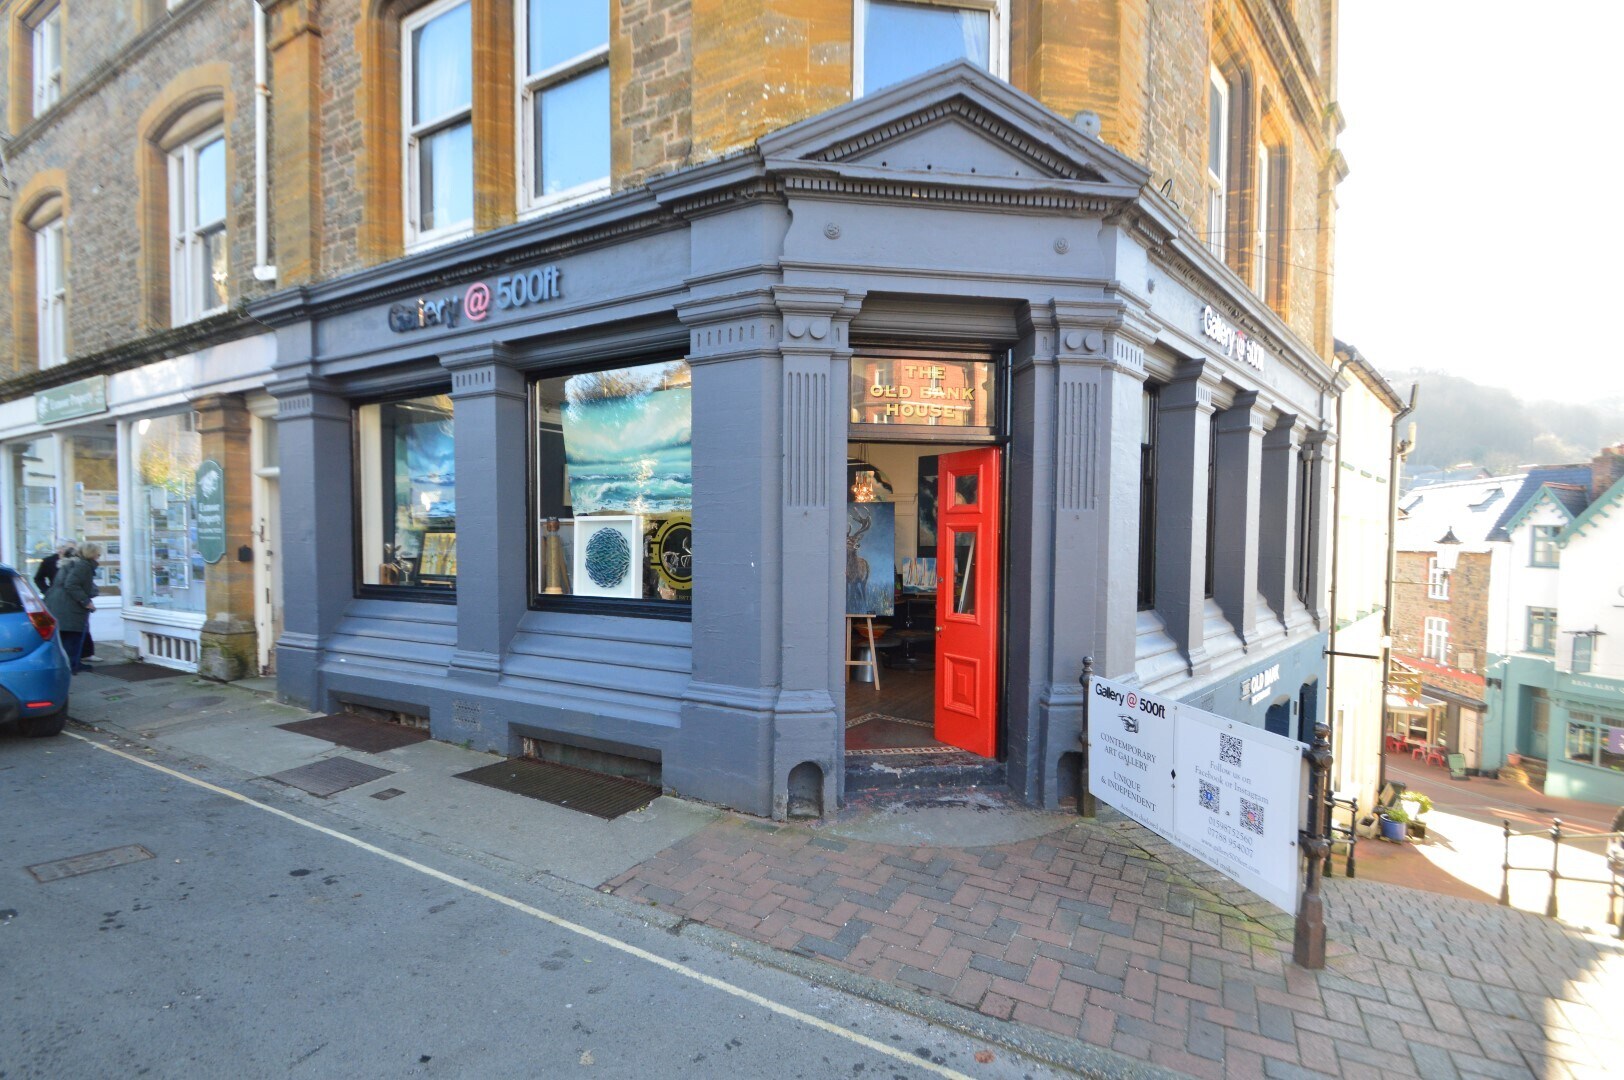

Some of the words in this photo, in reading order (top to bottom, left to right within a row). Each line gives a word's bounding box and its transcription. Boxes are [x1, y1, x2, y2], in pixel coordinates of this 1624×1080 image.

[463, 281, 491, 322] @
[496, 265, 561, 311] 500ft
[1204, 304, 1237, 357] Gallery
[905, 365, 947, 381] THE
[870, 384, 913, 400] OLD
[919, 386, 976, 401] BANK
[886, 402, 956, 419] HOUSE
[1095, 682, 1124, 707] Gallery
[1126, 690, 1137, 710] @
[1139, 697, 1165, 719] 500ft
[1100, 731, 1156, 765] CONTEMPORARY
[1105, 744, 1116, 757] ART
[1117, 750, 1148, 773] GALLERY
[1113, 770, 1140, 793] UNIQUE
[1195, 764, 1223, 785] Facebook
[1224, 780, 1232, 788] or
[1234, 782, 1268, 806] Instagram
[1210, 759, 1230, 776] Follow
[1232, 772, 1239, 780] us
[1241, 775, 1251, 785] on
[1101, 775, 1105, 784] &
[1107, 778, 1156, 812] INDEPENDENT
